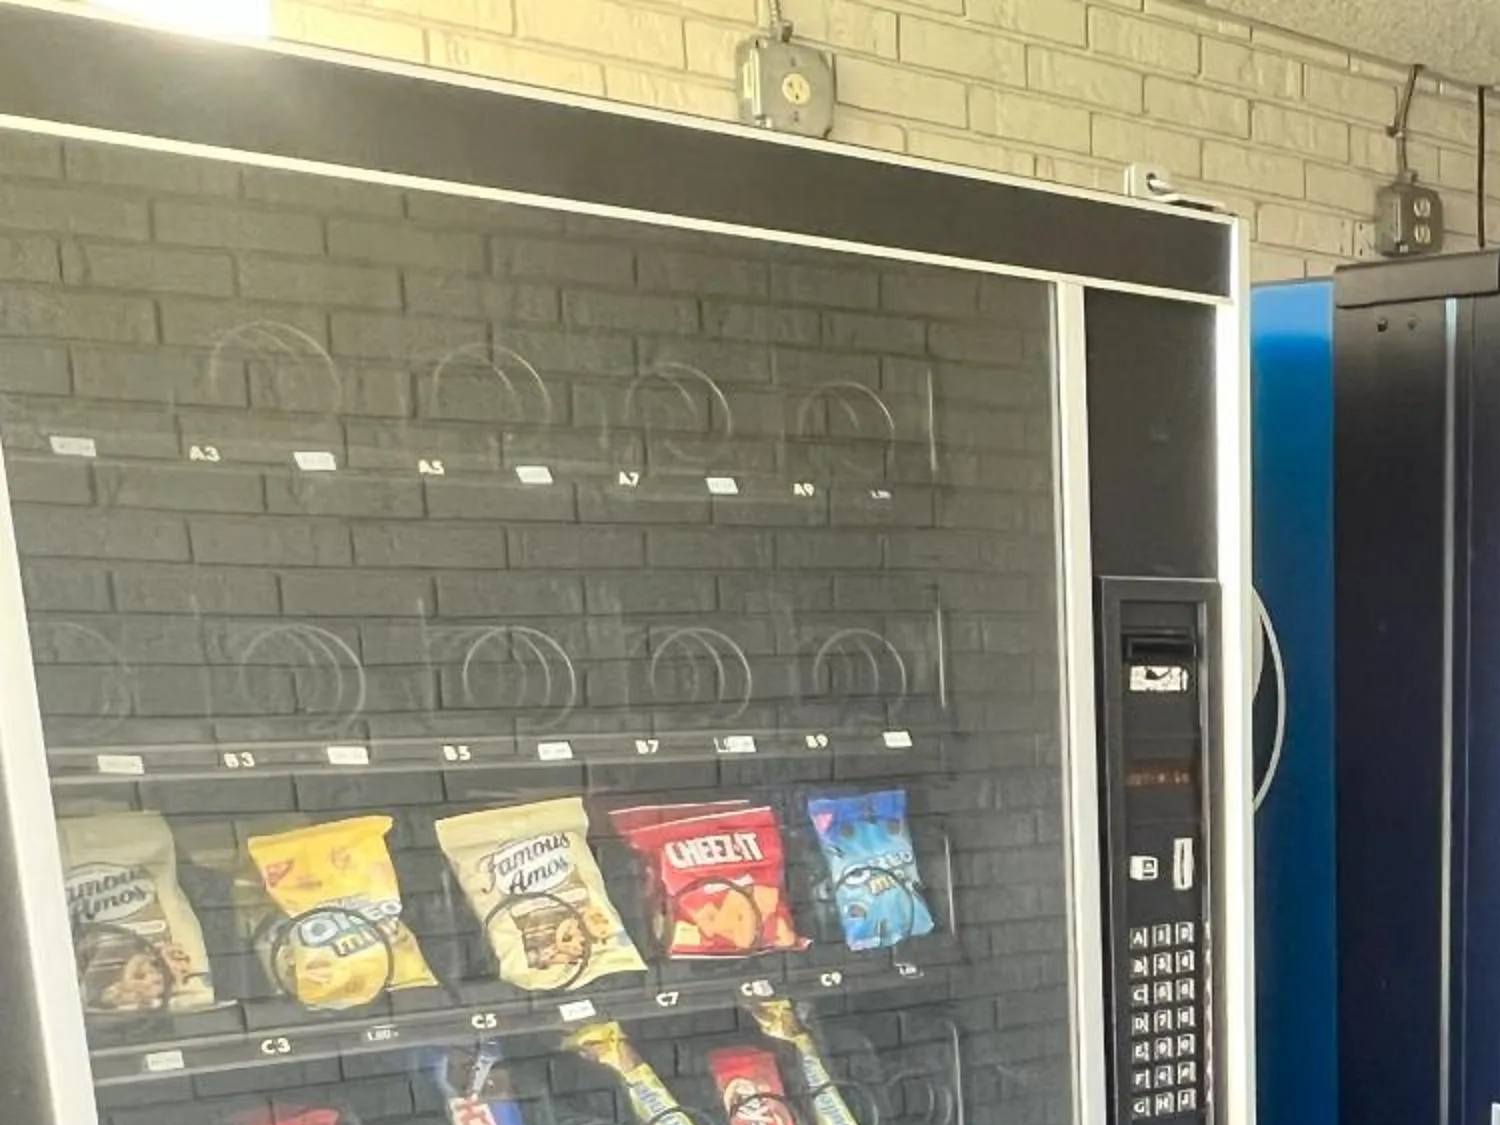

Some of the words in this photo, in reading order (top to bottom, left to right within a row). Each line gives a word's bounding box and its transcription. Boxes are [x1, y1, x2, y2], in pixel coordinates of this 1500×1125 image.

[190, 445, 221, 462] A3
[223, 751, 256, 768] B3
[477, 832, 570, 895] Famous
[508, 855, 569, 894] Amos
[820, 971, 843, 987] C9
[655, 992, 679, 1007] C7
[471, 1013, 497, 1029] C5
[261, 1037, 292, 1054] C3
